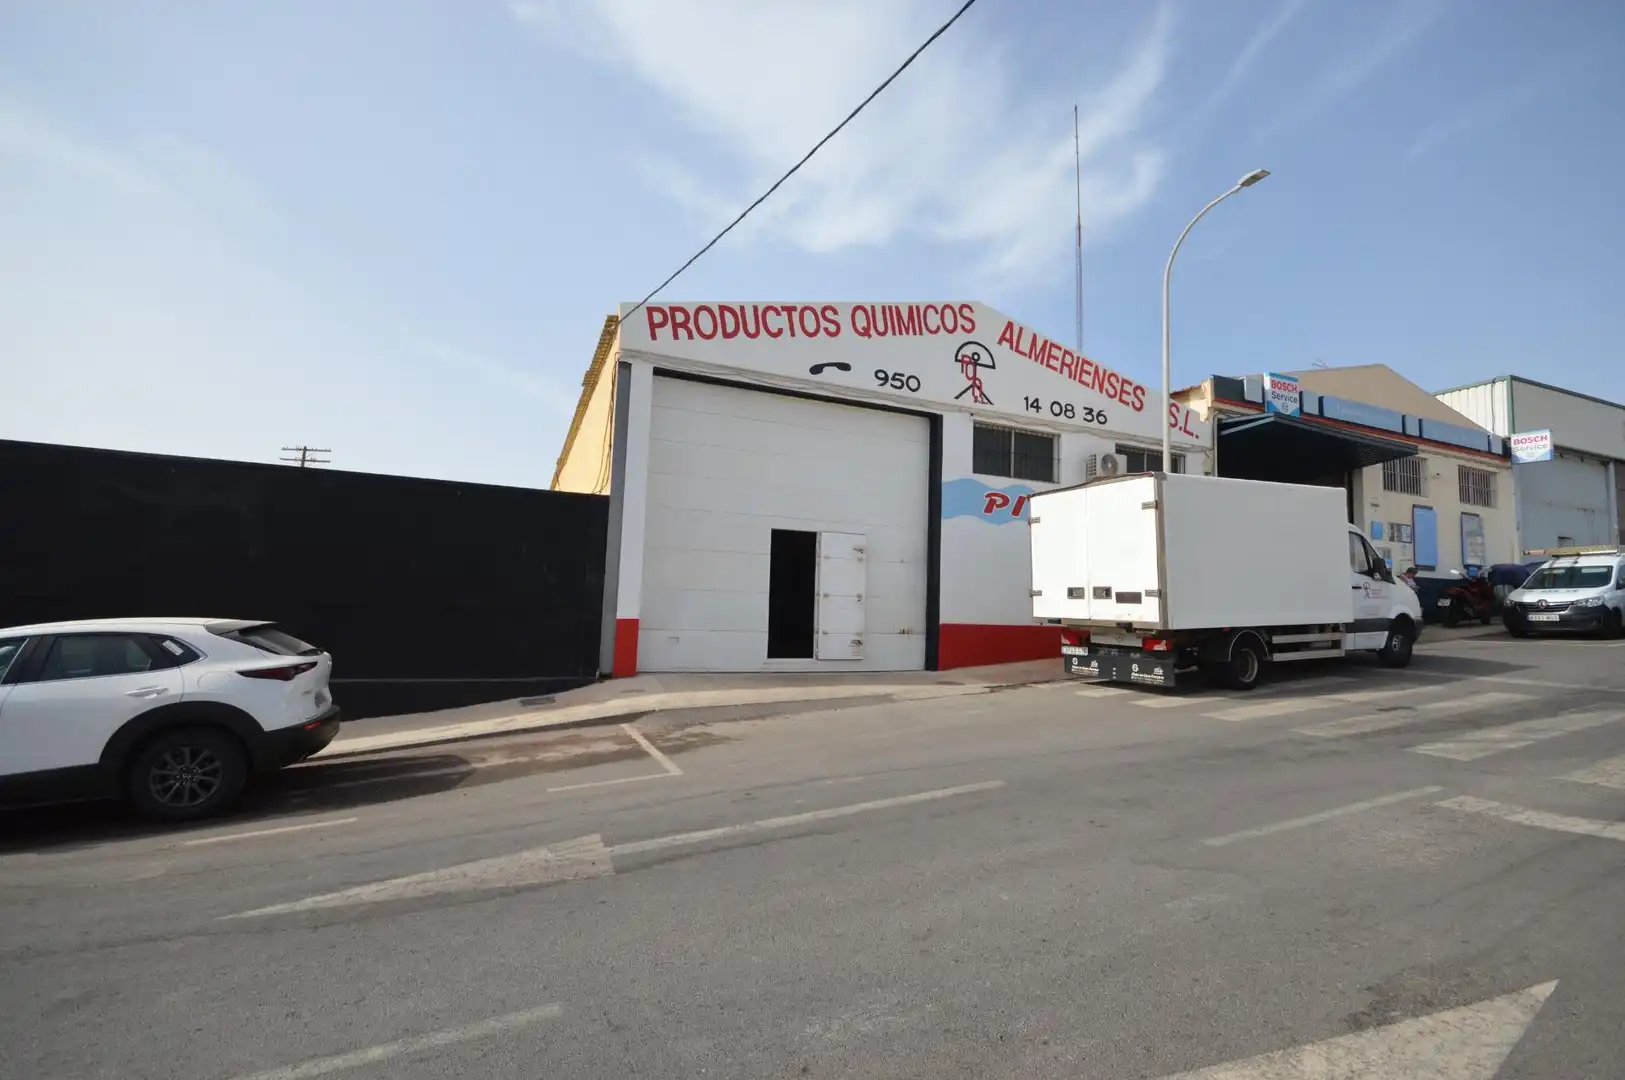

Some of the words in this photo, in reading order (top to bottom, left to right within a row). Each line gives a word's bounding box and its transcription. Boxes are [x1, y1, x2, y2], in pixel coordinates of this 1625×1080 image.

[646, 304, 842, 341] PRODUCTOS
[850, 303, 976, 339] QUIMICOS
[997, 320, 1146, 412] ALMERIENSES
[1168, 402, 1200, 439] S.L.
[1271, 379, 1298, 393] BOSCH
[873, 369, 921, 393] 950
[1023, 396, 1042, 413] 14
[1049, 400, 1076, 419] 08
[1083, 406, 1108, 425] 36
[1271, 391, 1299, 404] Service
[1513, 434, 1548, 446] BOSCH
[1512, 443, 1549, 453] Service
[983, 491, 1027, 518] PI
